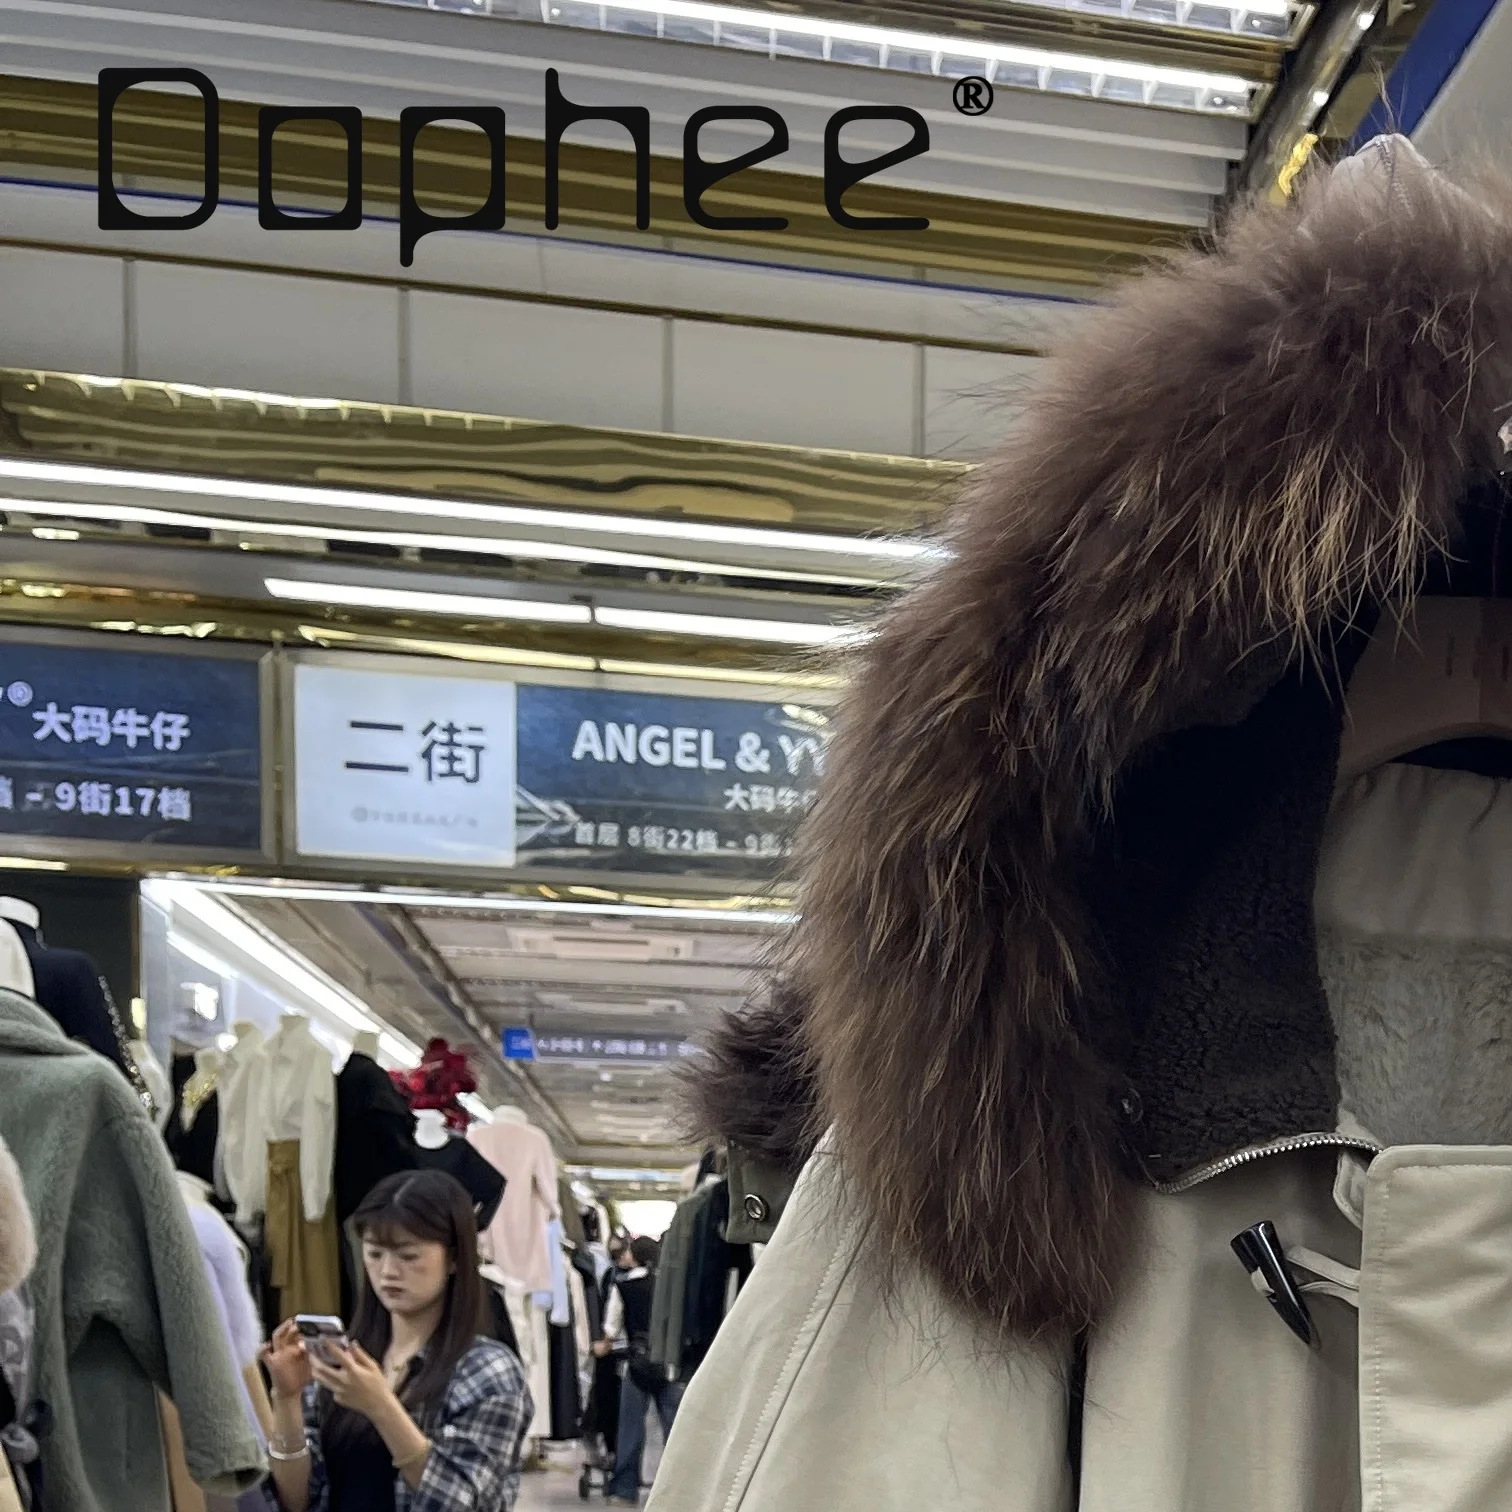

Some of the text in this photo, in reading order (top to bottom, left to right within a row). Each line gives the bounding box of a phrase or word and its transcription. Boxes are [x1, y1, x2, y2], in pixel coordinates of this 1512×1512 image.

[32, 701, 192, 751] 大码牛仔
[344, 720, 486, 784] 二街
[571, 719, 727, 771] ANGEL
[735, 731, 771, 774] &
[54, 781, 192, 822] 9街17档
